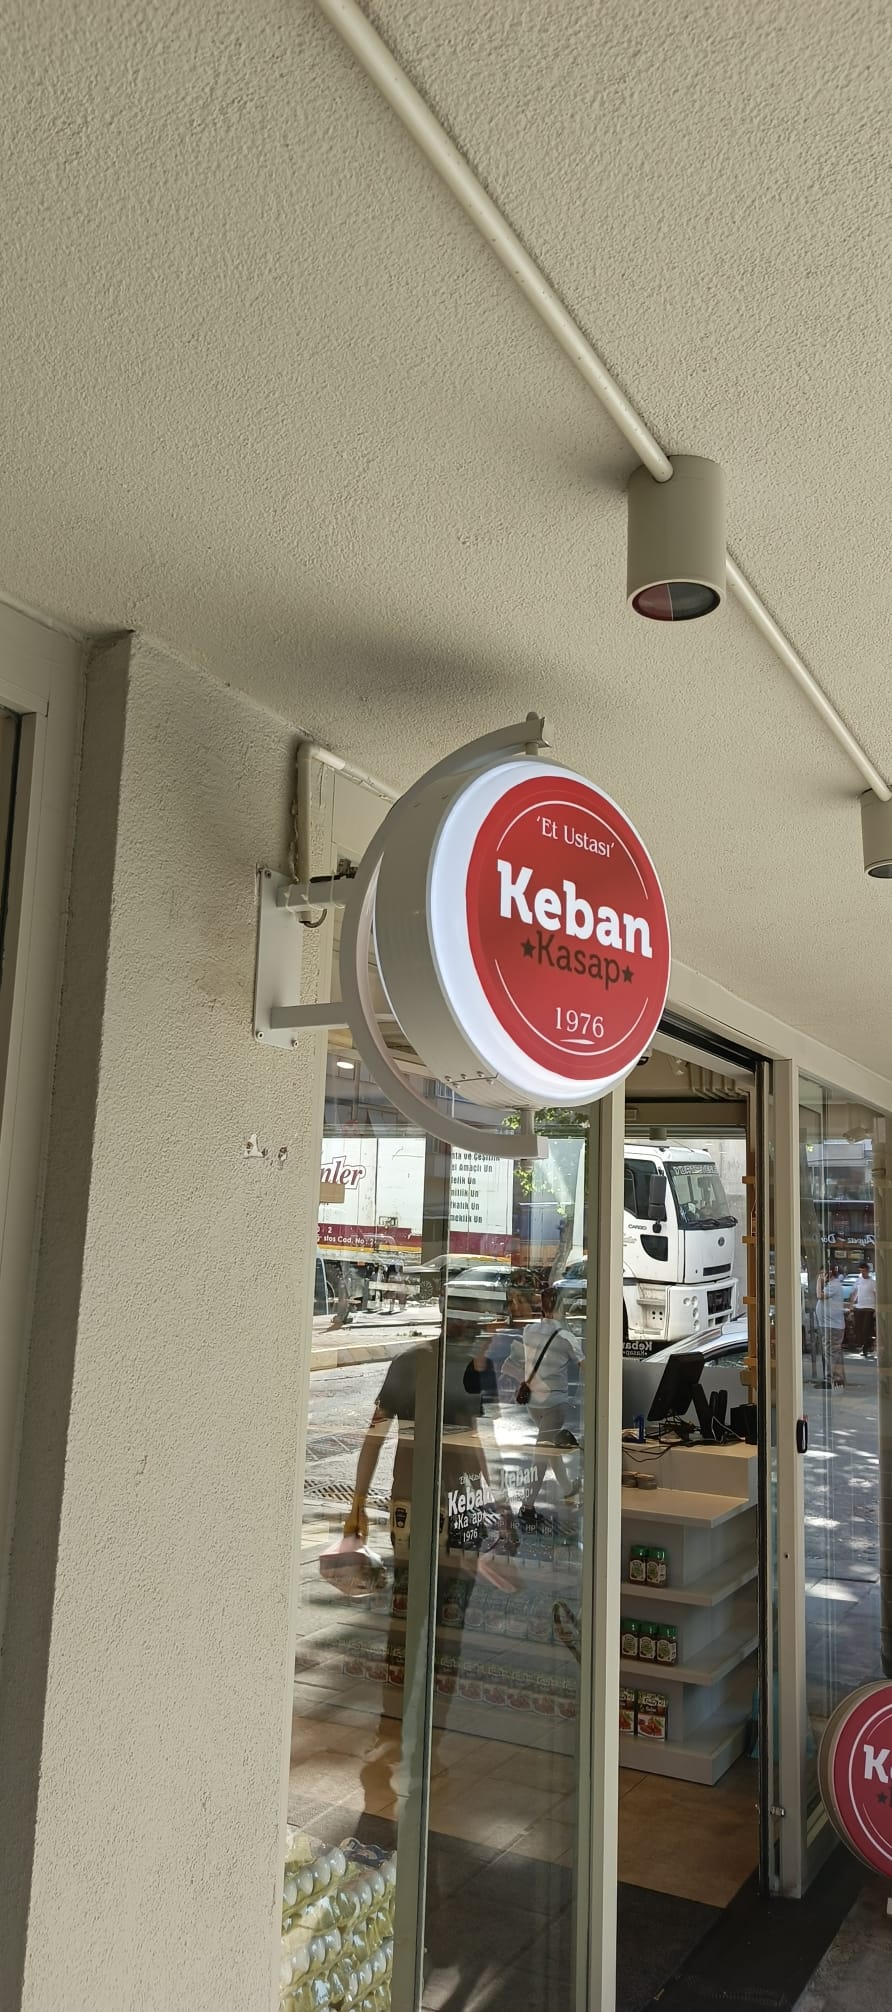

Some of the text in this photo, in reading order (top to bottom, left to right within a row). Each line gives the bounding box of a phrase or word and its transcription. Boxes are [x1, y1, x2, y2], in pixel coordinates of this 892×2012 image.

[497, 859, 653, 959] Keban
[535, 930, 620, 990] Kasap
[555, 1007, 605, 1038] 1976
[484, 1165, 493, 1173] Un
[468, 1177, 477, 1185] Un
[471, 1190, 479, 1198] Un
[471, 1203, 480, 1211] Un
[458, 1510, 483, 1529] Kaap
[463, 1528, 478, 1542] 1976
[863, 1743, 892, 1784] K
